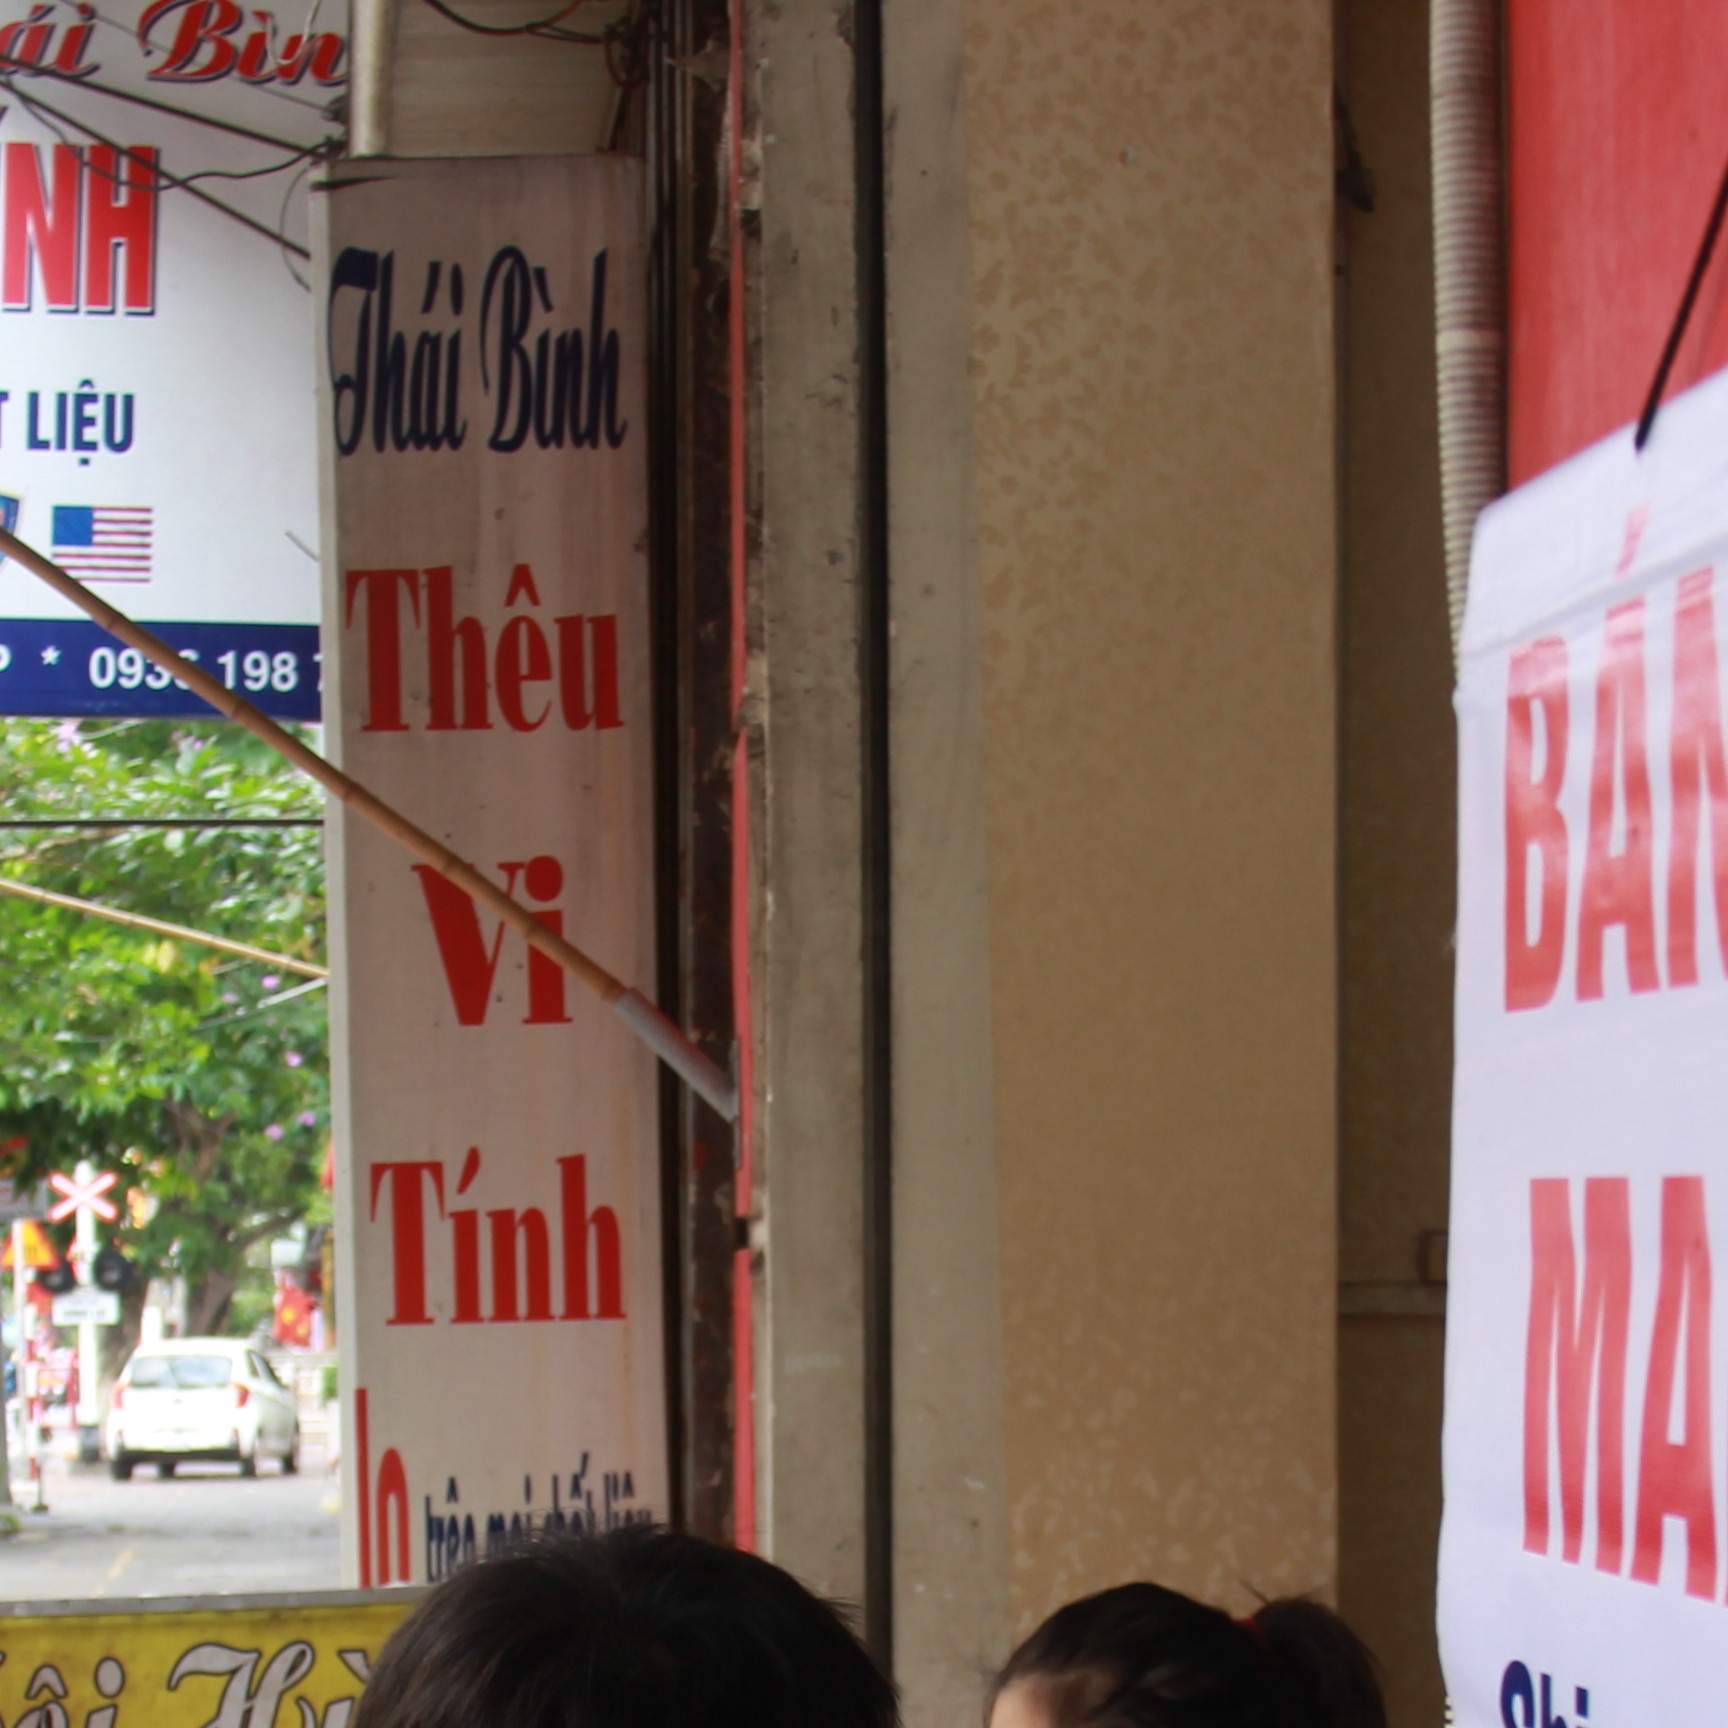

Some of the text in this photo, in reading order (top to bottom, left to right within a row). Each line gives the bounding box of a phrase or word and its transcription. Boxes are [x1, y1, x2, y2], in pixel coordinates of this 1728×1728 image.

[27, 378, 136, 466] LIỆU
[327, 245, 628, 456] Thái Bình
[216, 650, 299, 692] 198
[345, 563, 625, 732] Thêu
[411, 854, 572, 1026] Vi
[370, 1147, 627, 1327] Tính
